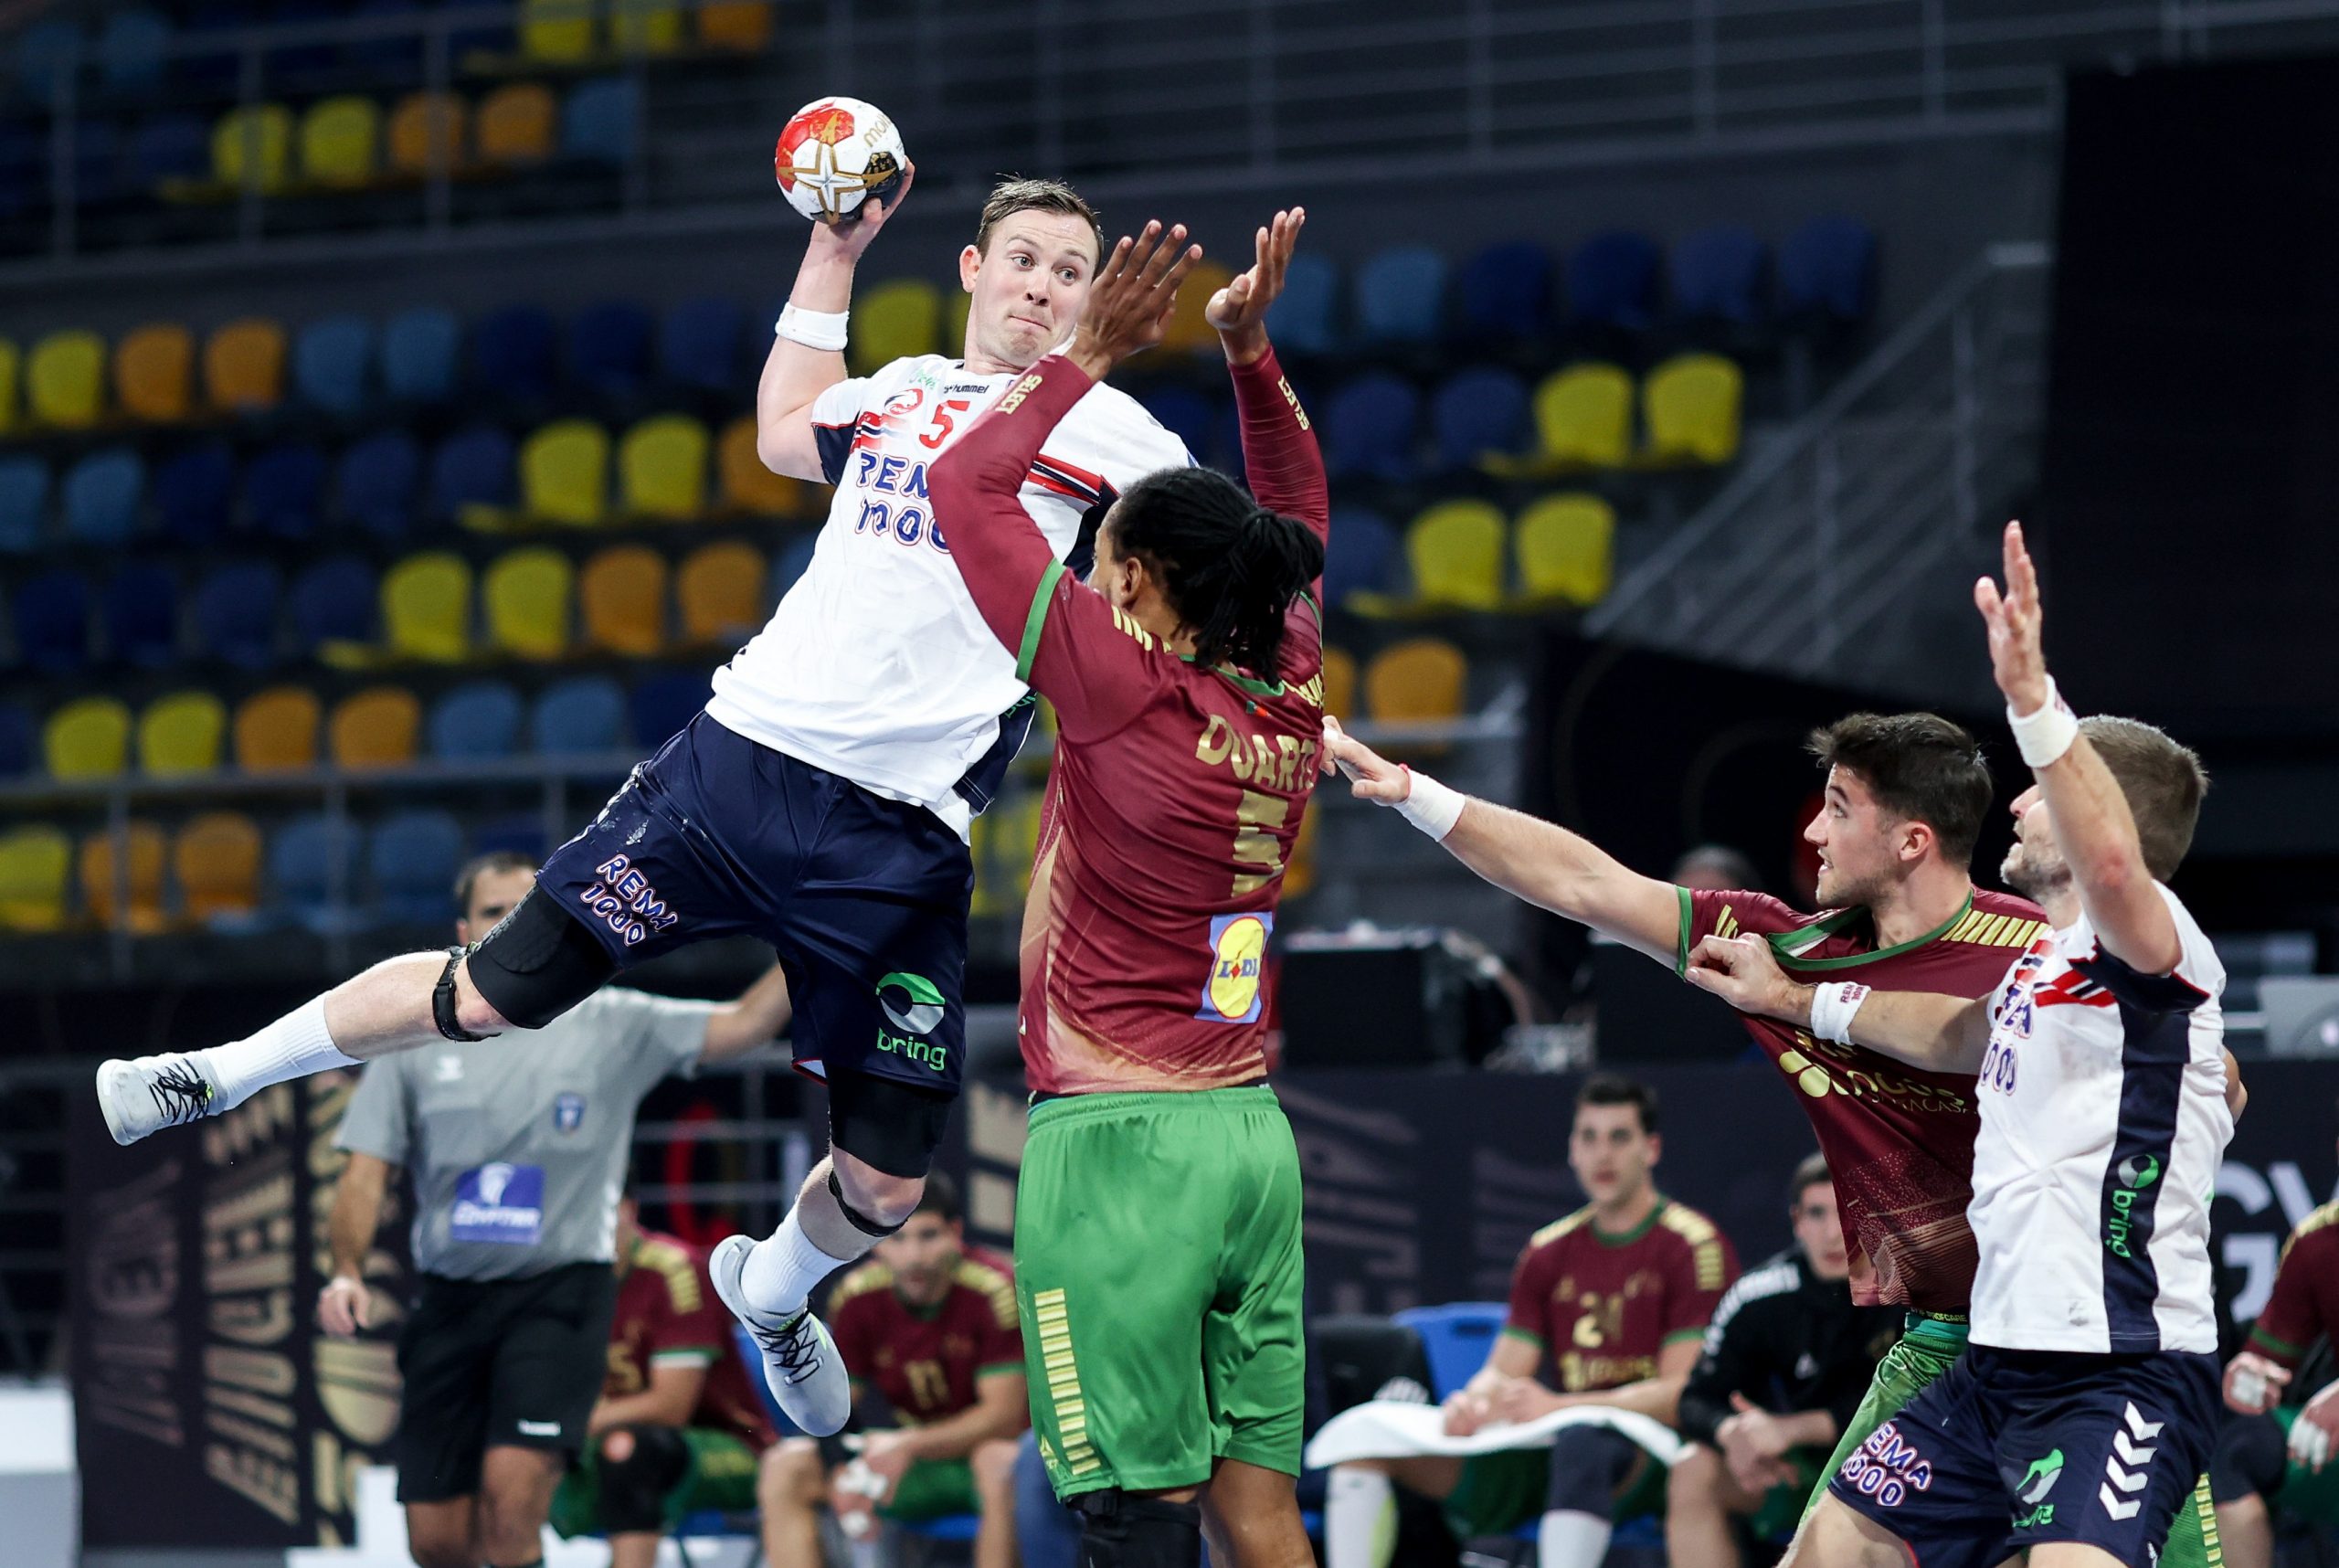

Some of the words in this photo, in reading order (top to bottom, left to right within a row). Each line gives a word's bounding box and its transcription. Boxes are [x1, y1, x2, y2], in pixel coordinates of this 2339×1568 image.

[953, 384, 990, 395] hummel
[995, 375, 1043, 415] SELECT
[1277, 375, 1310, 430] SELECT
[1231, 789, 1289, 897] 5
[580, 881, 645, 947] 1000
[596, 853, 678, 930] REMA
[876, 1026, 947, 1071] bring
[2105, 1189, 2138, 1258] bring
[1865, 1421, 1932, 1491] EMA
